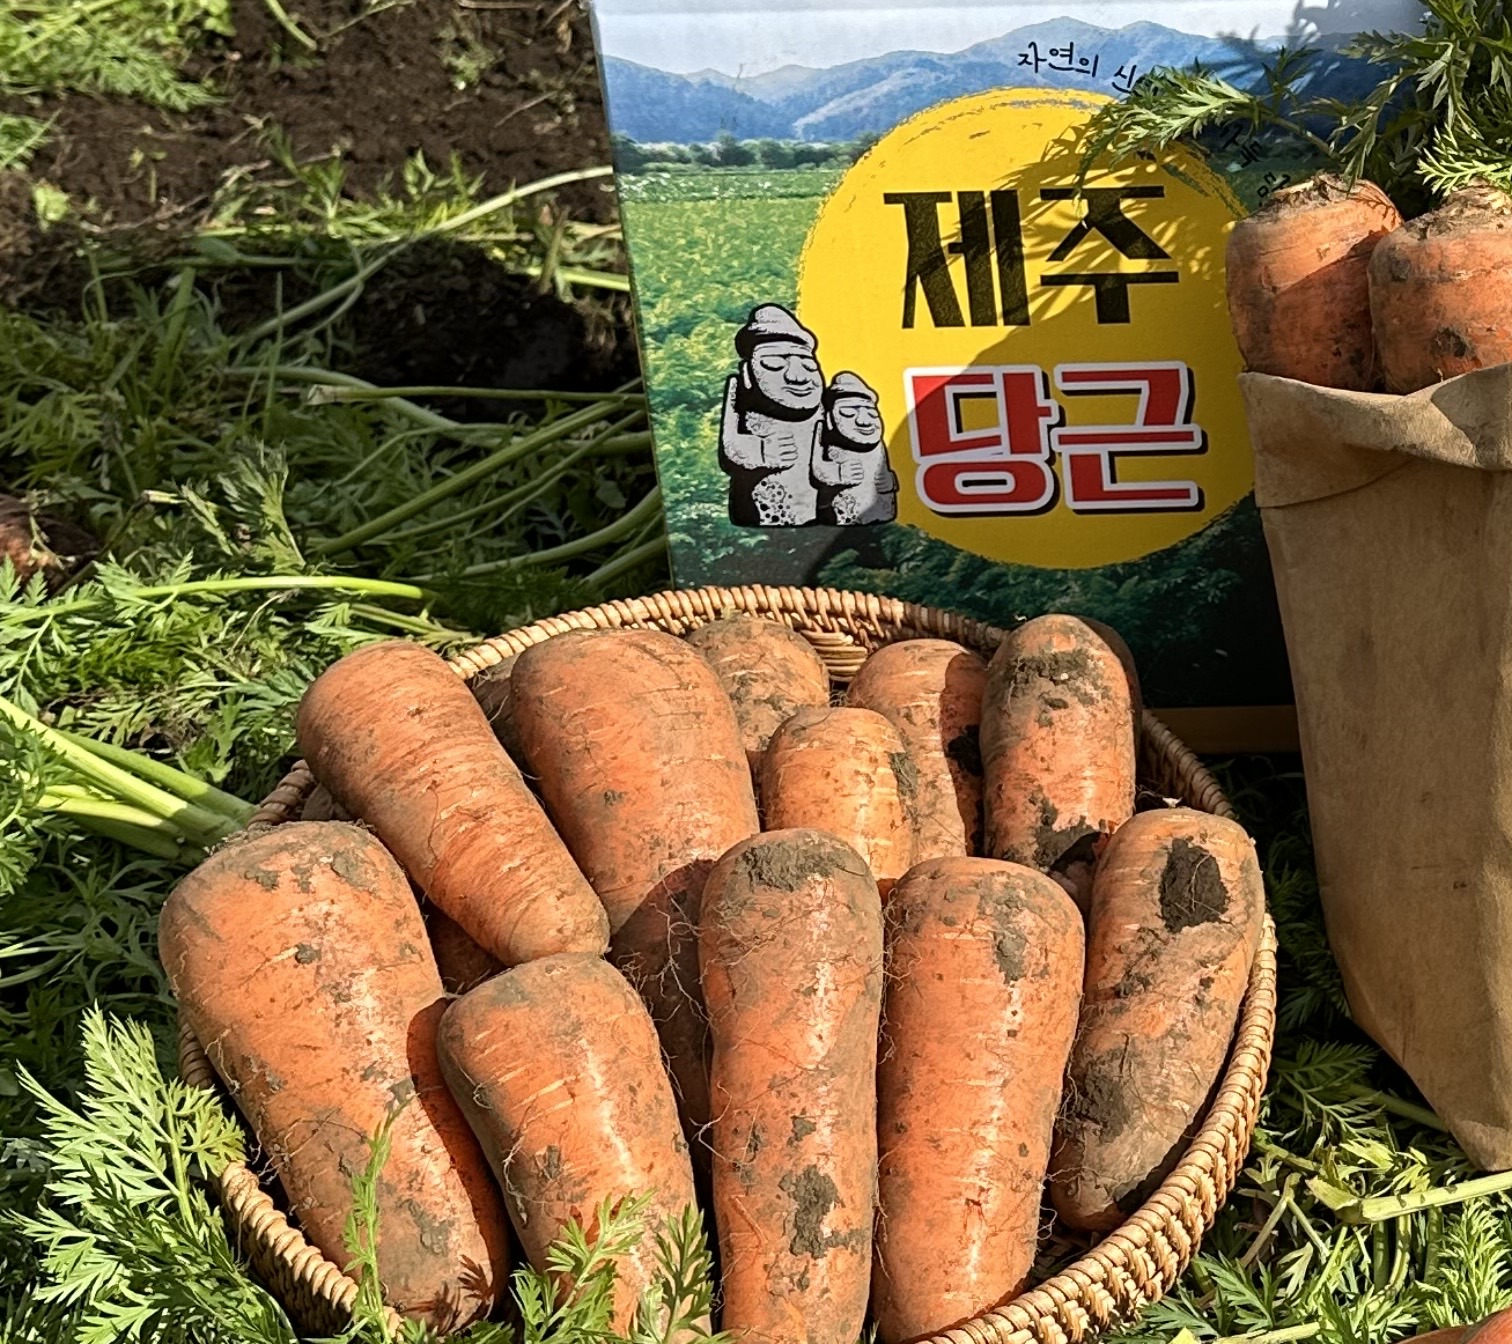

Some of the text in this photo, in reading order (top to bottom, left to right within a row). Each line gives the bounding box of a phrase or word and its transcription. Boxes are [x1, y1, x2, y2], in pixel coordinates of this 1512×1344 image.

[1017, 41, 1100, 79] 자연의
[883, 185, 1180, 329] 제주
[905, 362, 1206, 514] 당근
